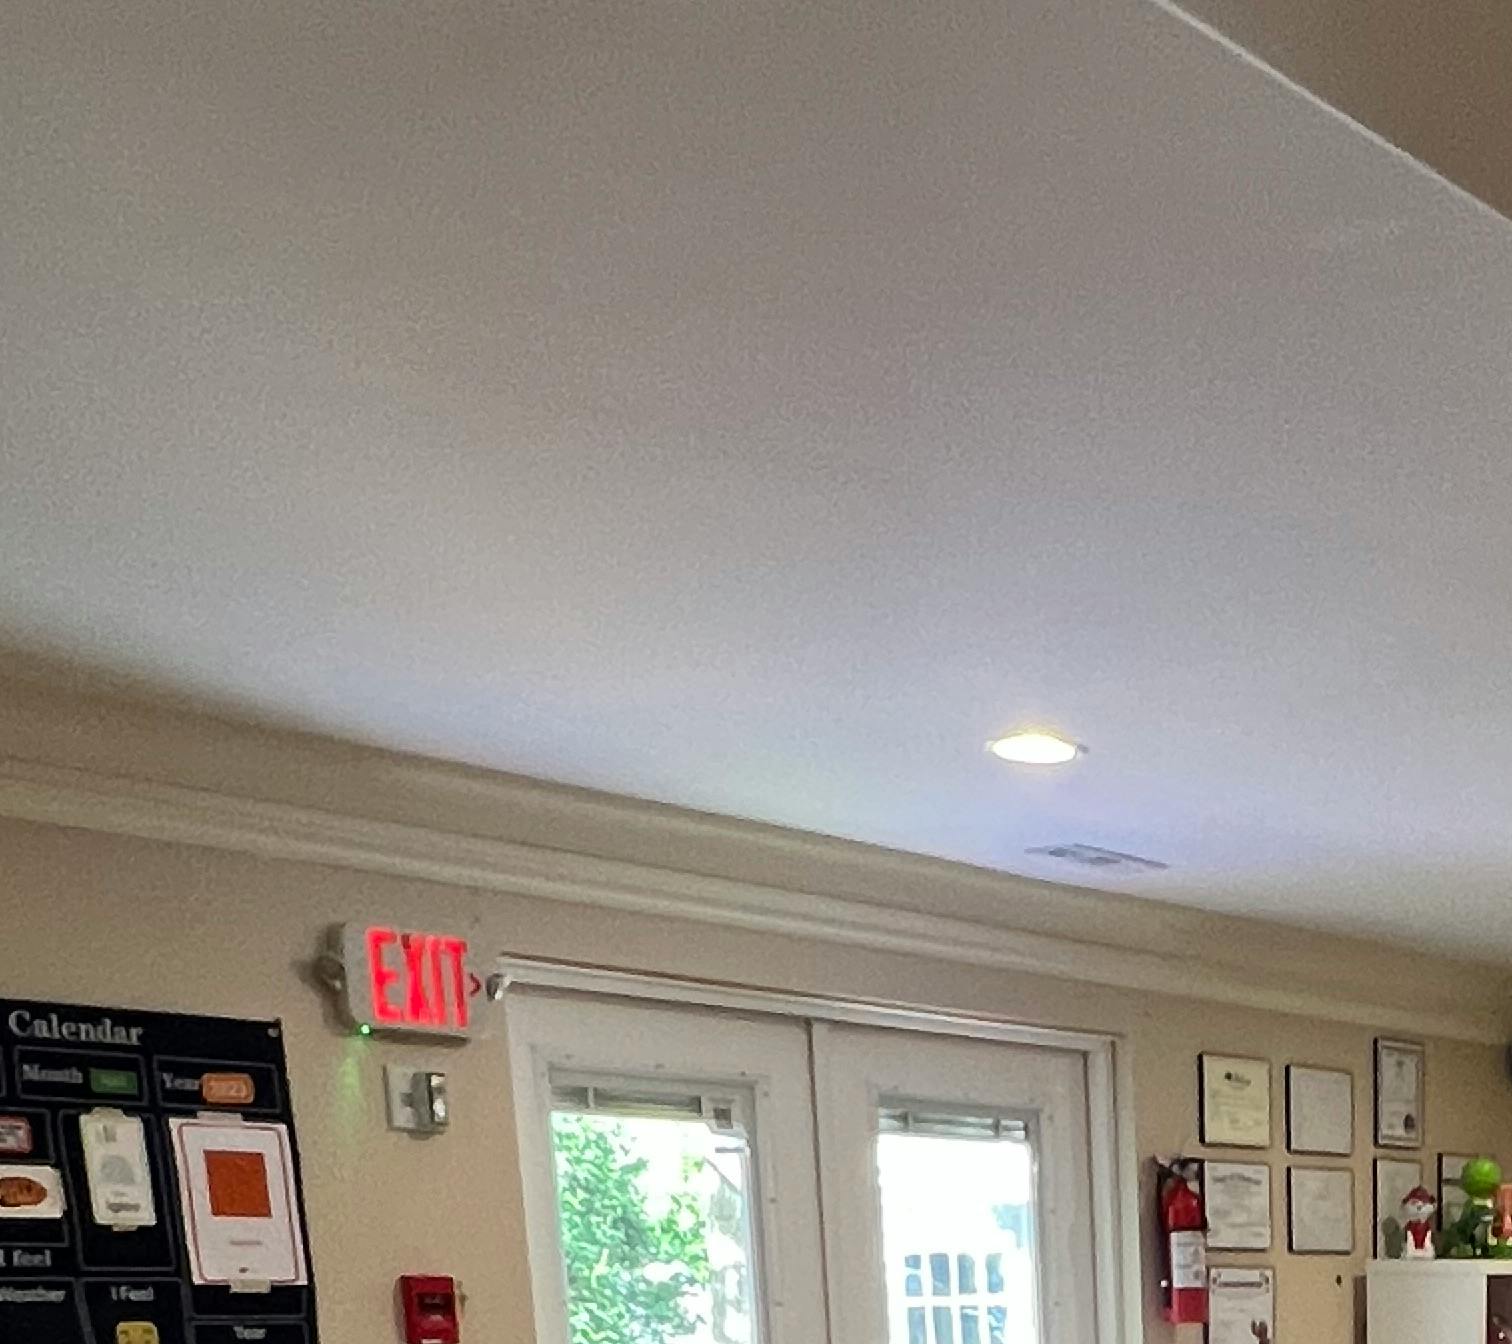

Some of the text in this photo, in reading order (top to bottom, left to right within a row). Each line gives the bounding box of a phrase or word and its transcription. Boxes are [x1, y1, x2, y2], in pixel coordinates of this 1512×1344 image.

[366, 926, 469, 1028] EXIT
[8, 1009, 144, 1045] Calendar
[22, 1063, 84, 1084] Month
[161, 1071, 200, 1091] Year
